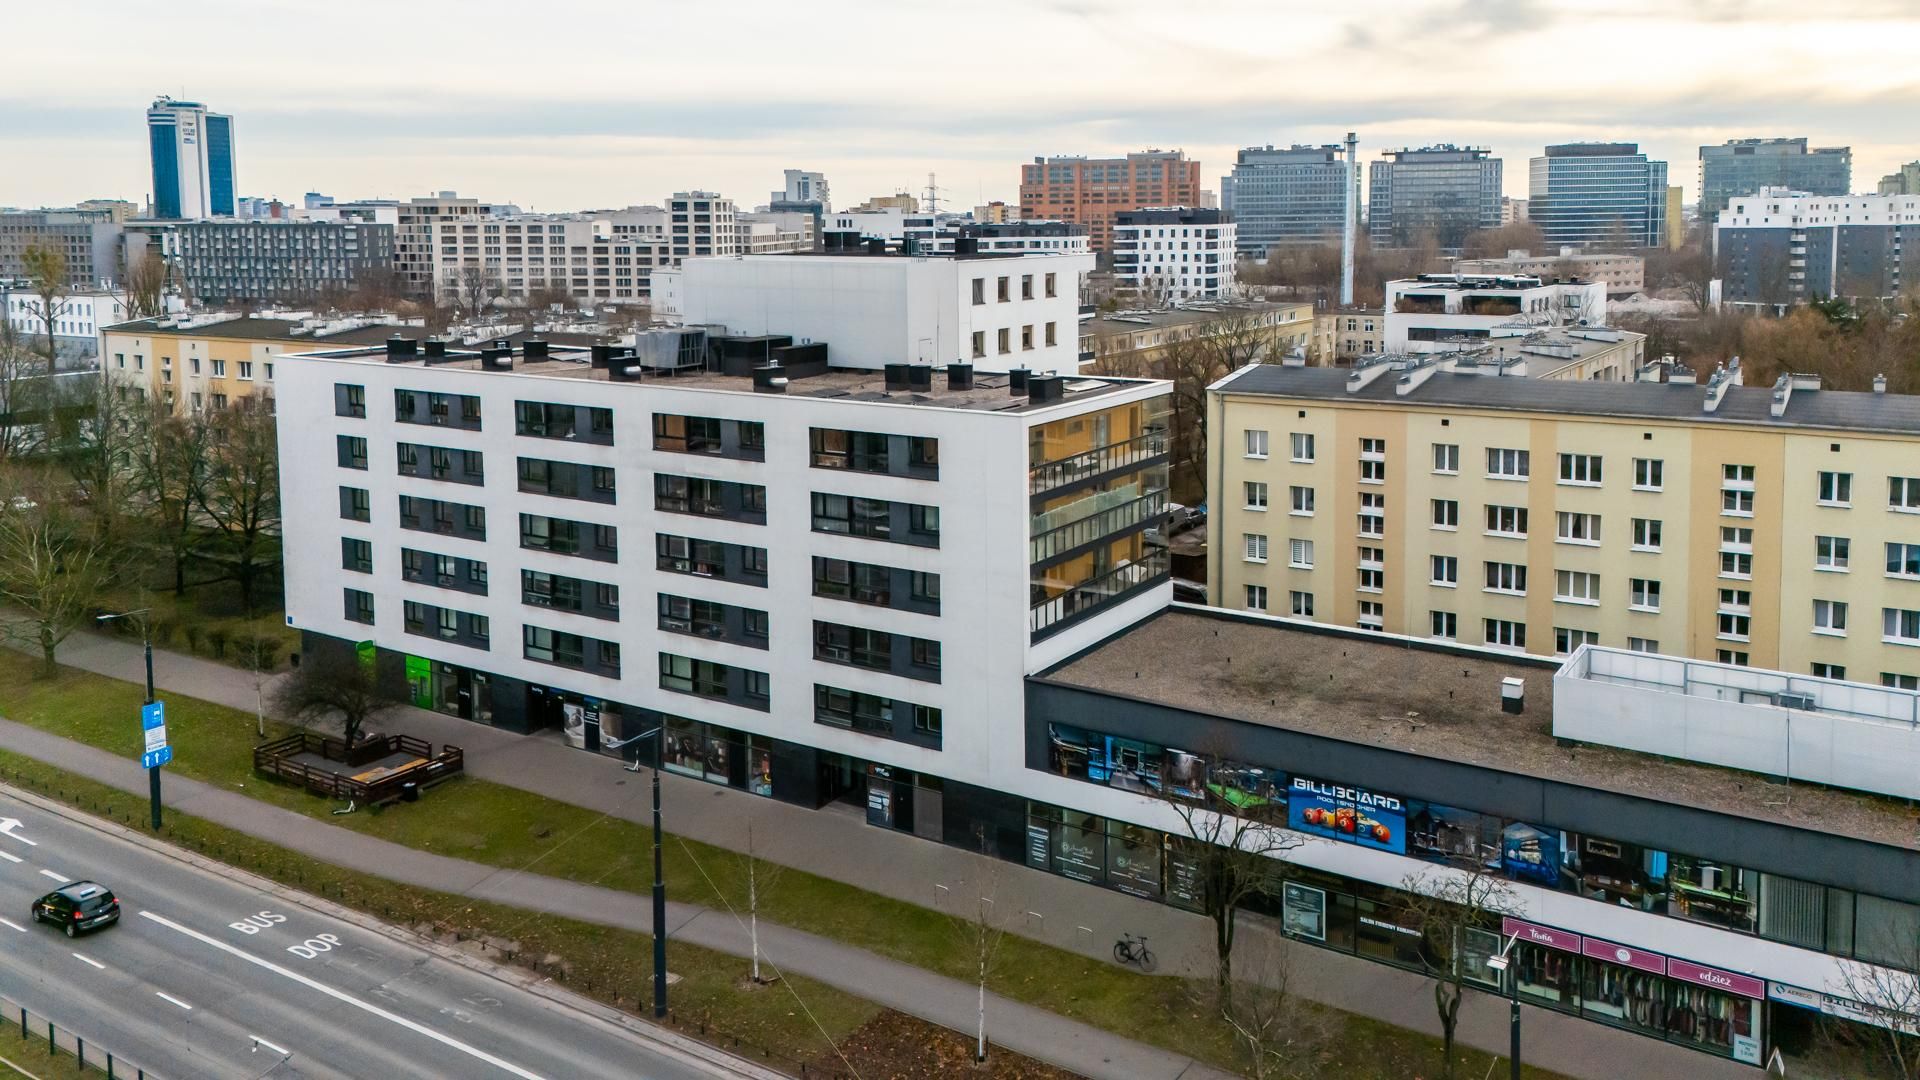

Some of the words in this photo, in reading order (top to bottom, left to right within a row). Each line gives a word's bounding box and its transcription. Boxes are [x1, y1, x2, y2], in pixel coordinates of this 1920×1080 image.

[1294, 778, 1400, 810] BILLBOARD
[229, 911, 287, 935] BUS
[286, 933, 342, 959] DOP
